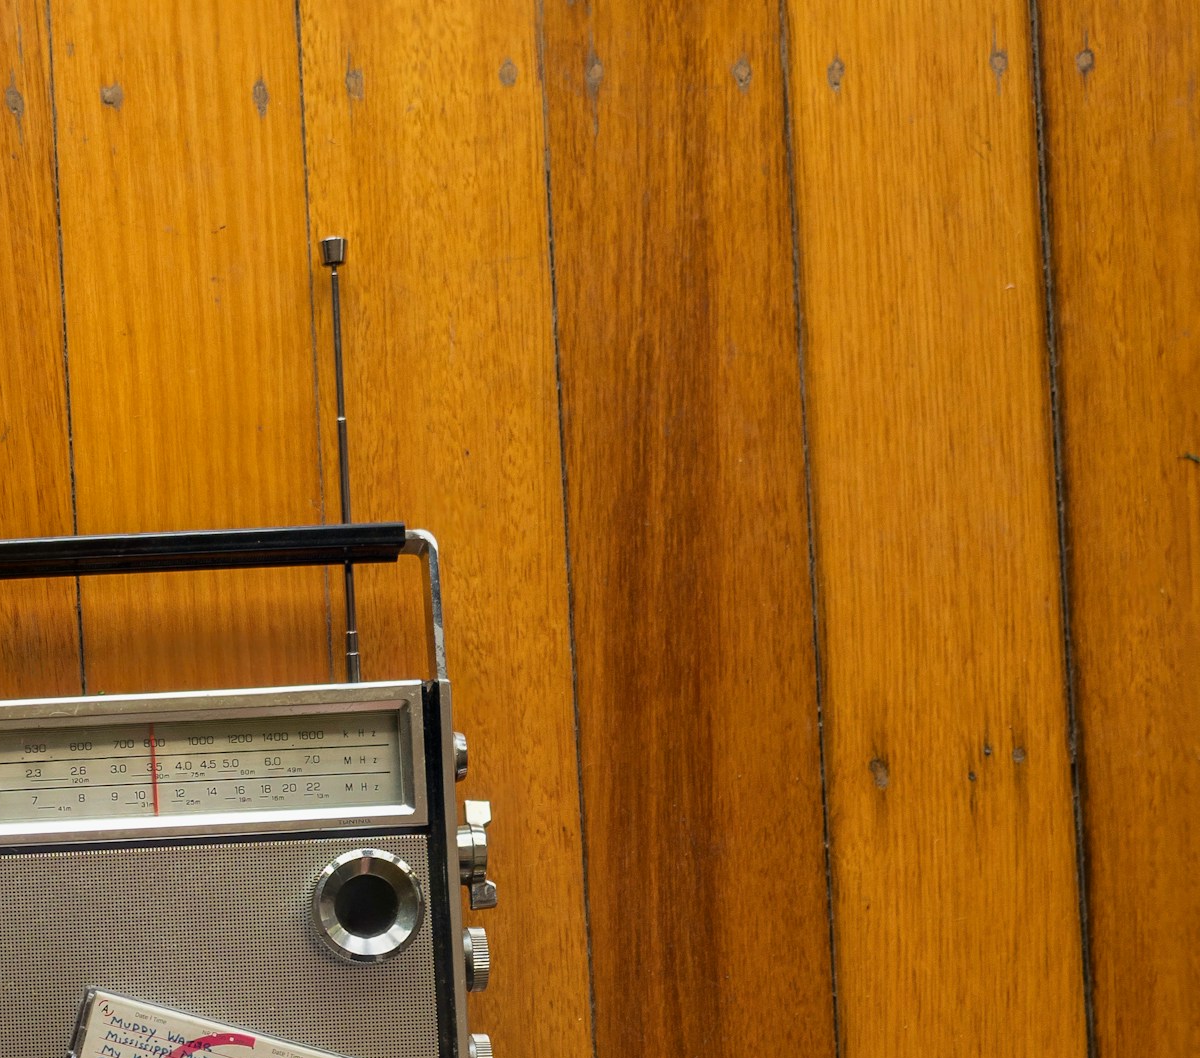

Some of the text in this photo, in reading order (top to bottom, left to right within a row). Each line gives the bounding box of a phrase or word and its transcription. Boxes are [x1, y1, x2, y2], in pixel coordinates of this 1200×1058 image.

[25, 731, 324, 753] 530 600 700 800 1000 1200 1400 1600
[26, 769, 41, 778] 2.3
[70, 767, 86, 775] 2.6
[110, 765, 127, 773] 3.0
[175, 761, 192, 771] 4.0
[200, 759, 216, 769] 4.5
[223, 759, 239, 768] 5.0
[264, 757, 281, 766] 6.0
[304, 755, 320, 764] 7.0
[32, 796, 38, 805] 7
[79, 794, 85, 802] 8
[112, 792, 118, 800] 9
[135, 791, 145, 799] 10
[175, 789, 185, 798] 12
[207, 787, 217, 796] 14
[235, 785, 245, 795] 16
[261, 784, 271, 794] 18
[282, 784, 296, 793] 20
[306, 782, 320, 791] 22
[338, 818, 371, 826] TUNING
[111, 1016, 156, 1041] MUDDY
